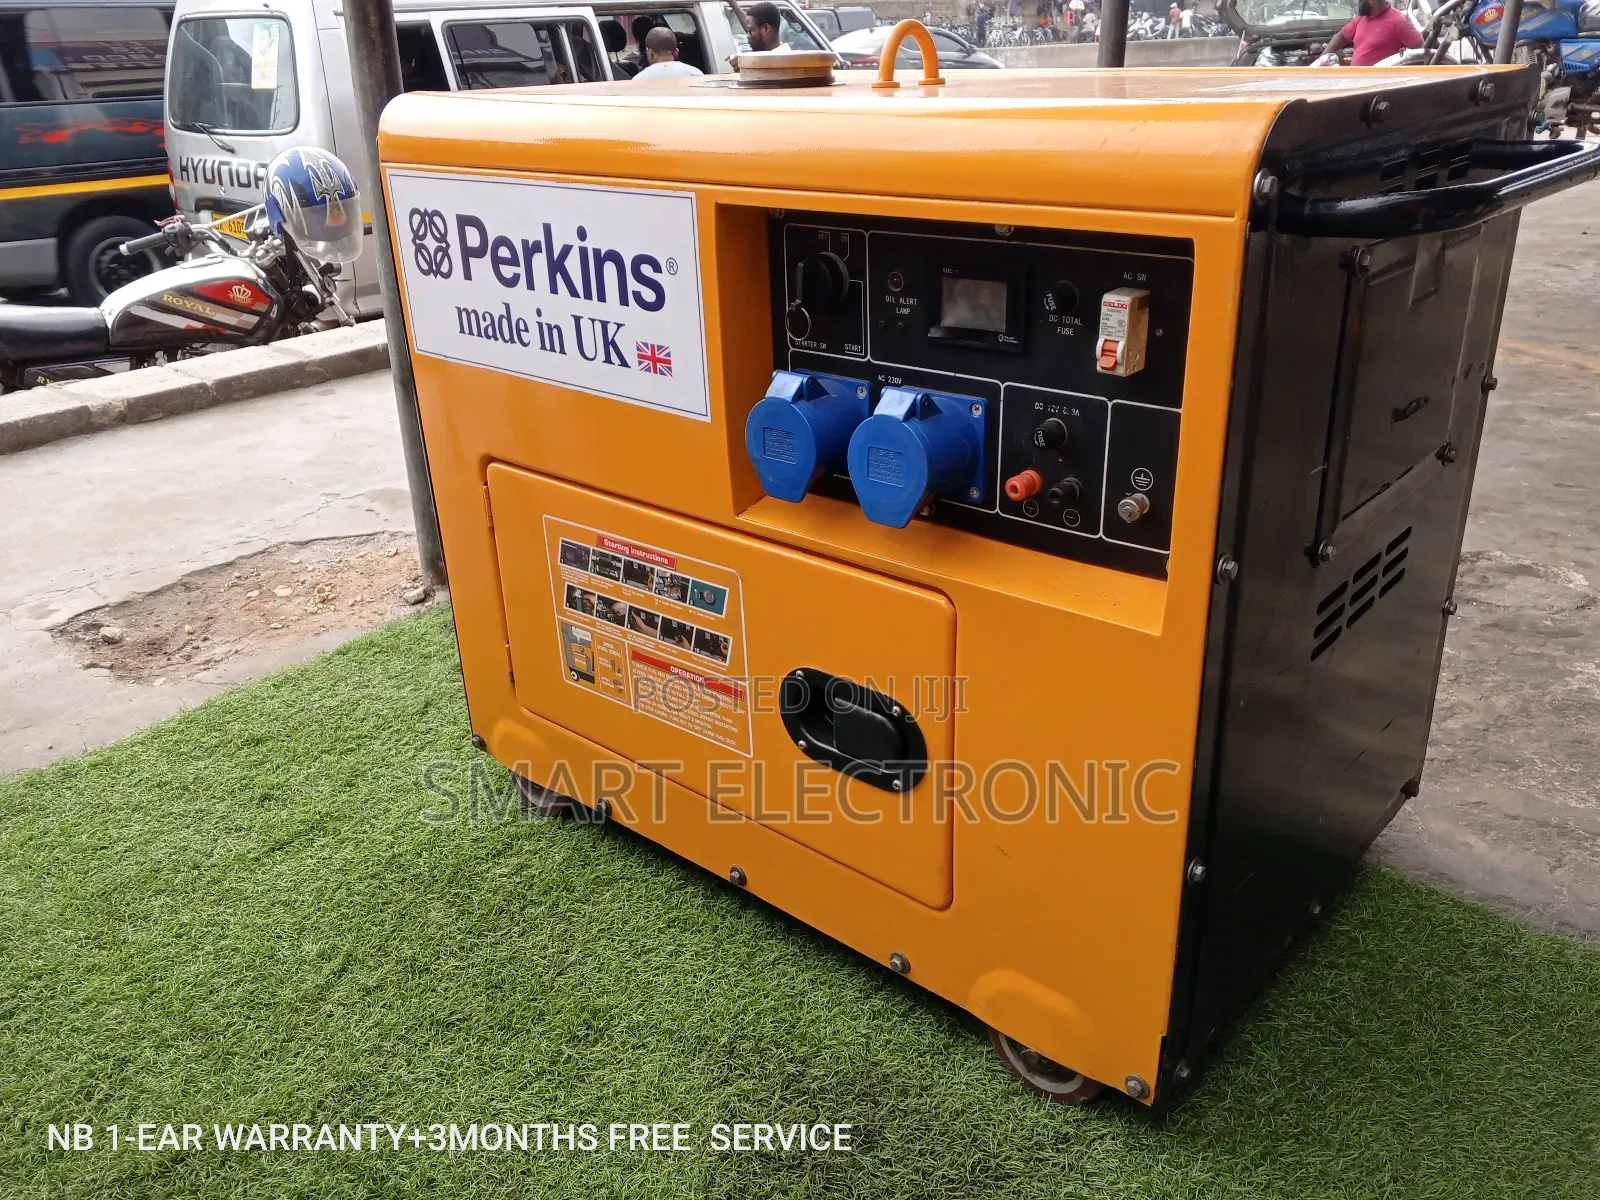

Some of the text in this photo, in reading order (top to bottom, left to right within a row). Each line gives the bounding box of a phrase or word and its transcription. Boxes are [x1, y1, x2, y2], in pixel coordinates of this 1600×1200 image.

[180, 156, 269, 189] HYUNDA
[455, 213, 666, 312] Perkins
[1123, 272, 1147, 281] AC SW
[162, 293, 216, 315] ROYAL
[885, 295, 918, 306] OIL ALERT
[1046, 293, 1057, 311] FUSE
[895, 306, 911, 315] LAMP
[1049, 314, 1083, 326] DC TOTAL
[455, 301, 632, 369] made in UK
[1057, 326, 1074, 336] FUSE
[794, 339, 818, 349] STARTER
[844, 343, 862, 352] START
[887, 376, 902, 385] 220V
[1034, 402, 1044, 411] DC
[1037, 430, 1046, 447] FUSE
[603, 538, 669, 565] Starting Instructions
